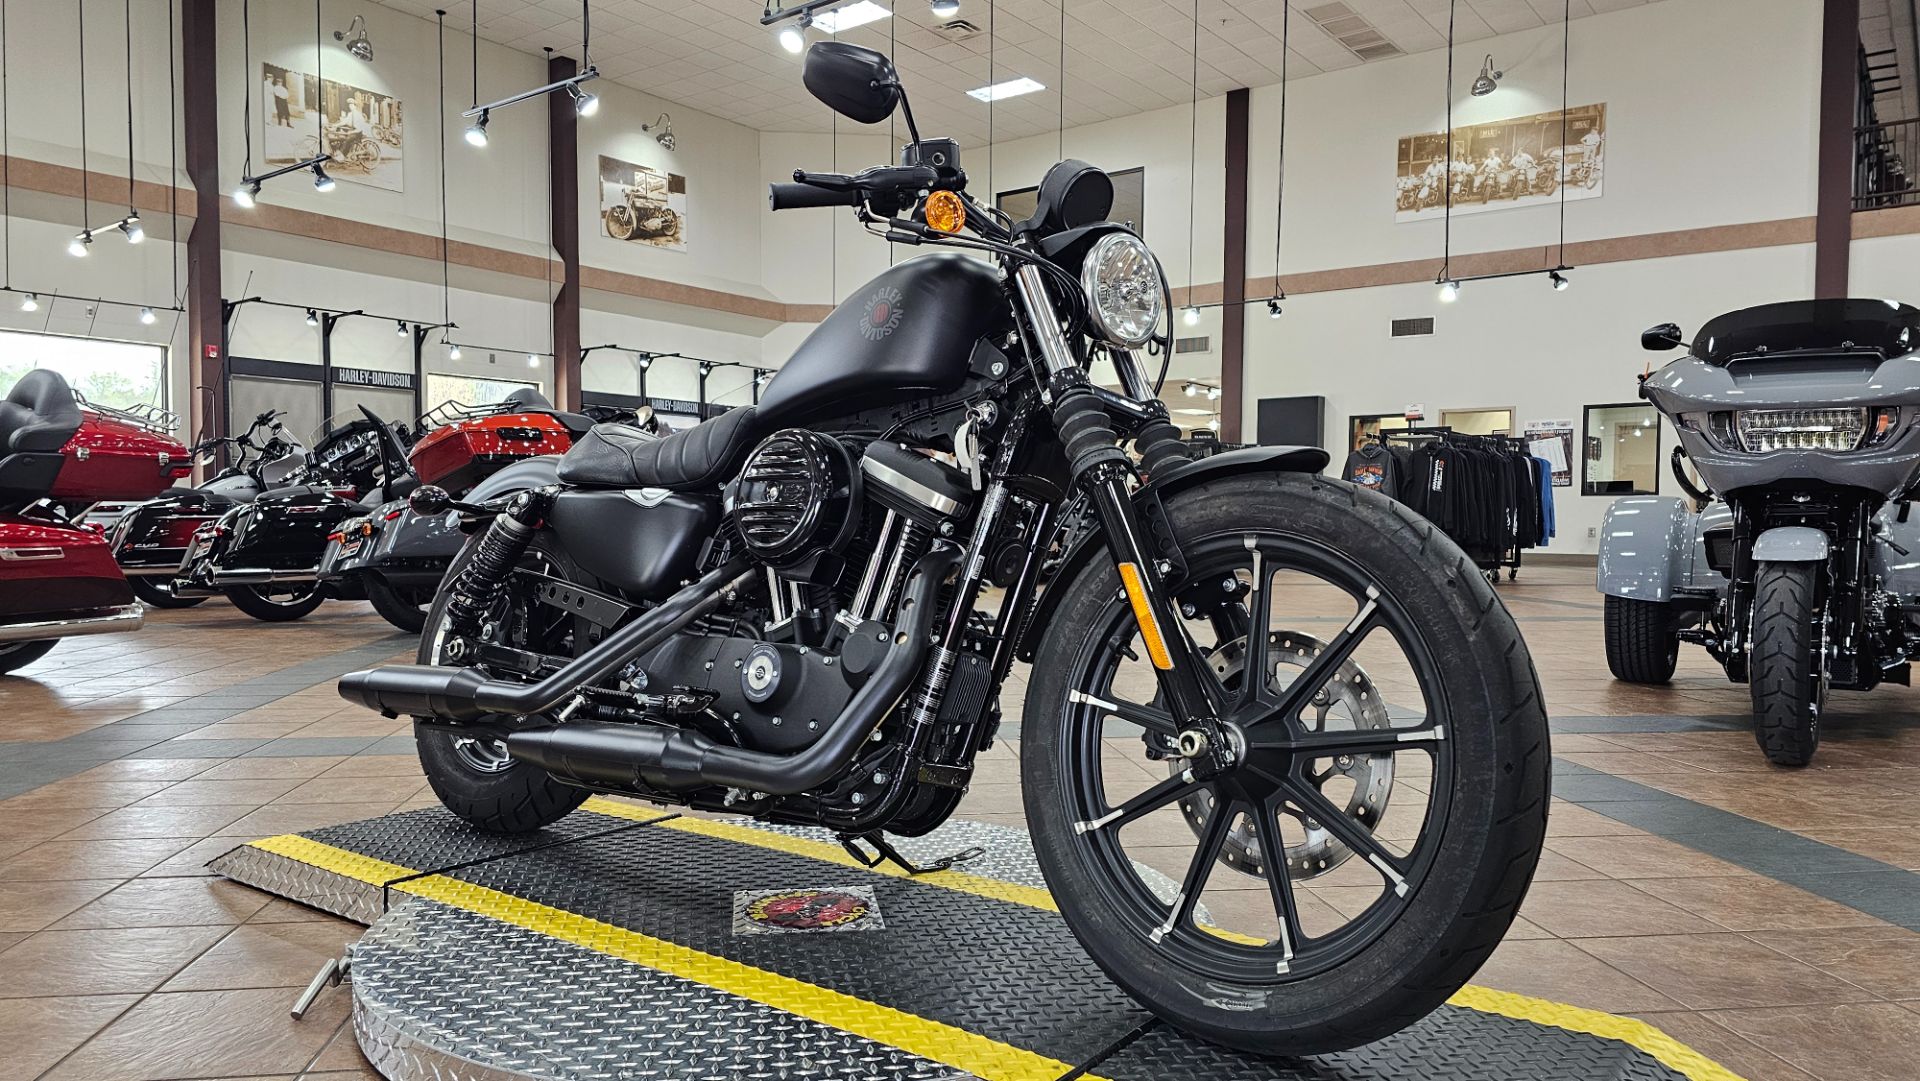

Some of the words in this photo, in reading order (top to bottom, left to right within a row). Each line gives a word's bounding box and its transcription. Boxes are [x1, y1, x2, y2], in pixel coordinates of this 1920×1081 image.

[864, 287, 902, 311] HARLEY
[859, 308, 903, 340] DAVIDSON
[339, 368, 411, 388] HARLEY-DAVIDSON
[651, 398, 699, 413] HARLEY-DAVIDSON
